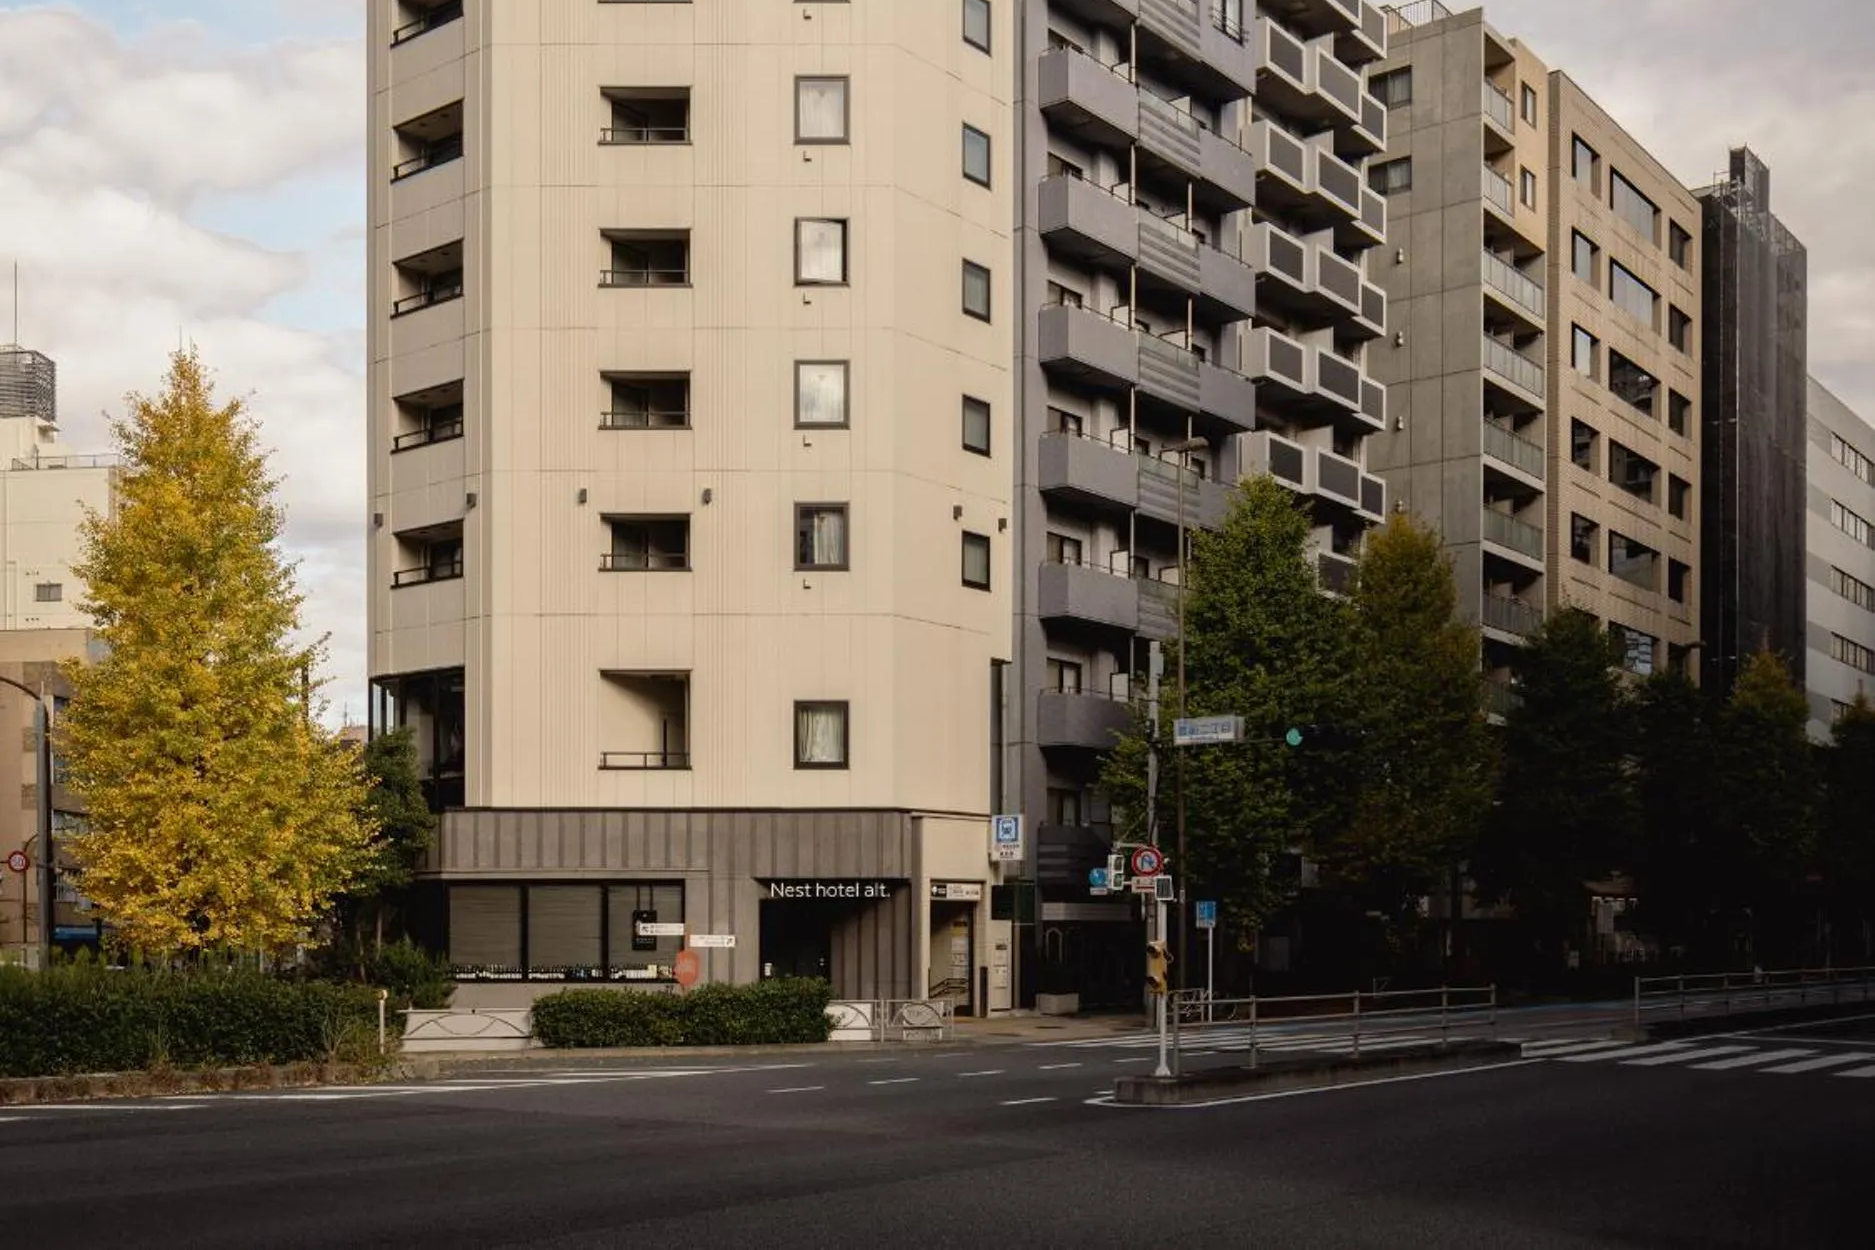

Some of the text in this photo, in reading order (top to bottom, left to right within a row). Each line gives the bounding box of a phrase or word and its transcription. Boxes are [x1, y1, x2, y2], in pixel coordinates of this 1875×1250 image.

[770, 882, 891, 898] Nest hotel alt.
